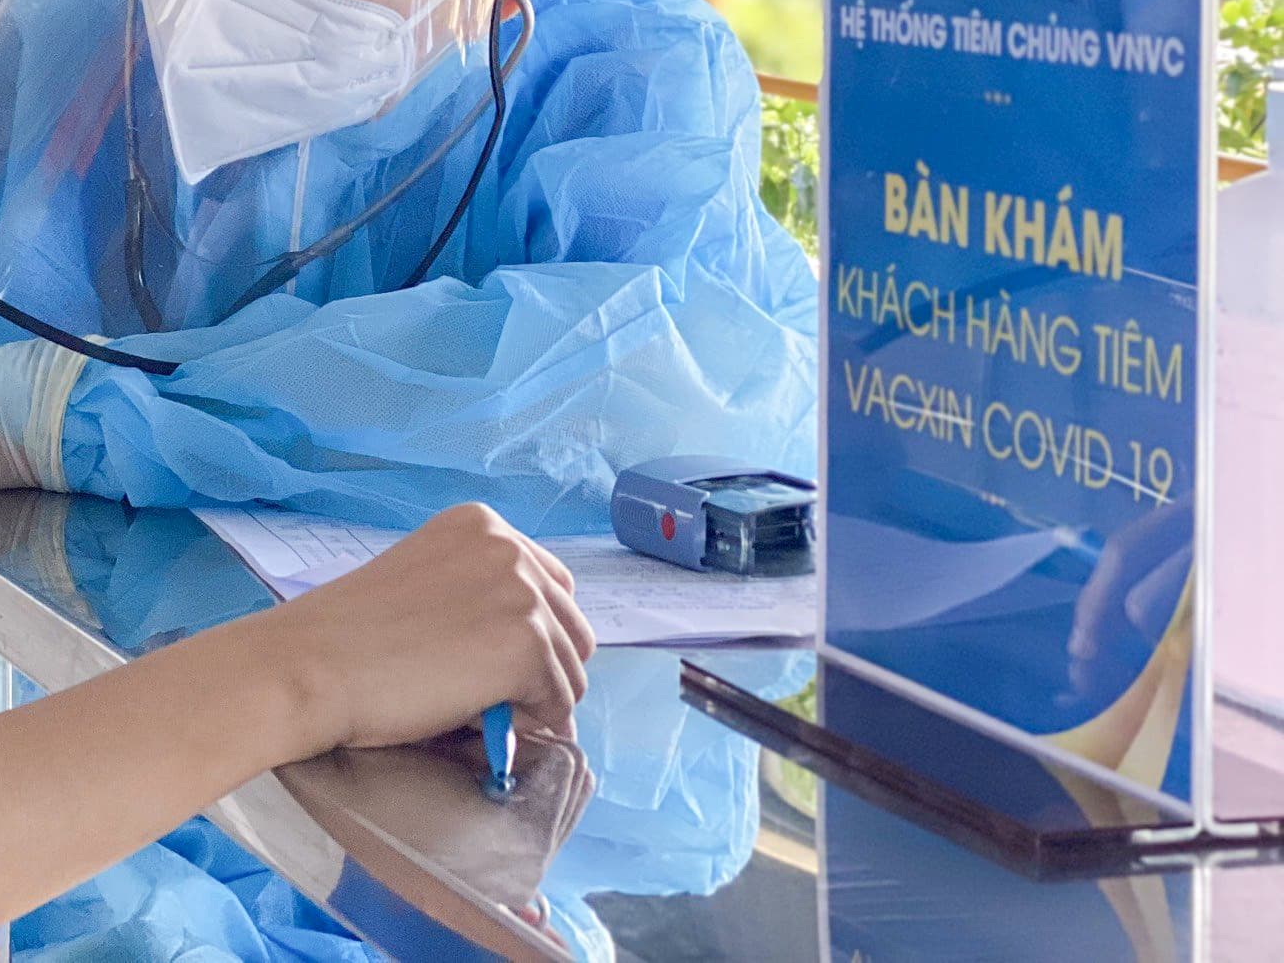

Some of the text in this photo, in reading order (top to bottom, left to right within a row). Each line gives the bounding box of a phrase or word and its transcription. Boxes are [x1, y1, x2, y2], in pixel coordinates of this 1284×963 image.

[951, 8, 1002, 57] TIÊM
[1007, 12, 1101, 68] CHỦNG
[1106, 31, 1185, 78] VNVC
[883, 159, 1123, 281] BÀN KHÁM
[837, 263, 1184, 404] KHÁCH HÀNG TIÊM
[843, 358, 973, 449] VACXIN
